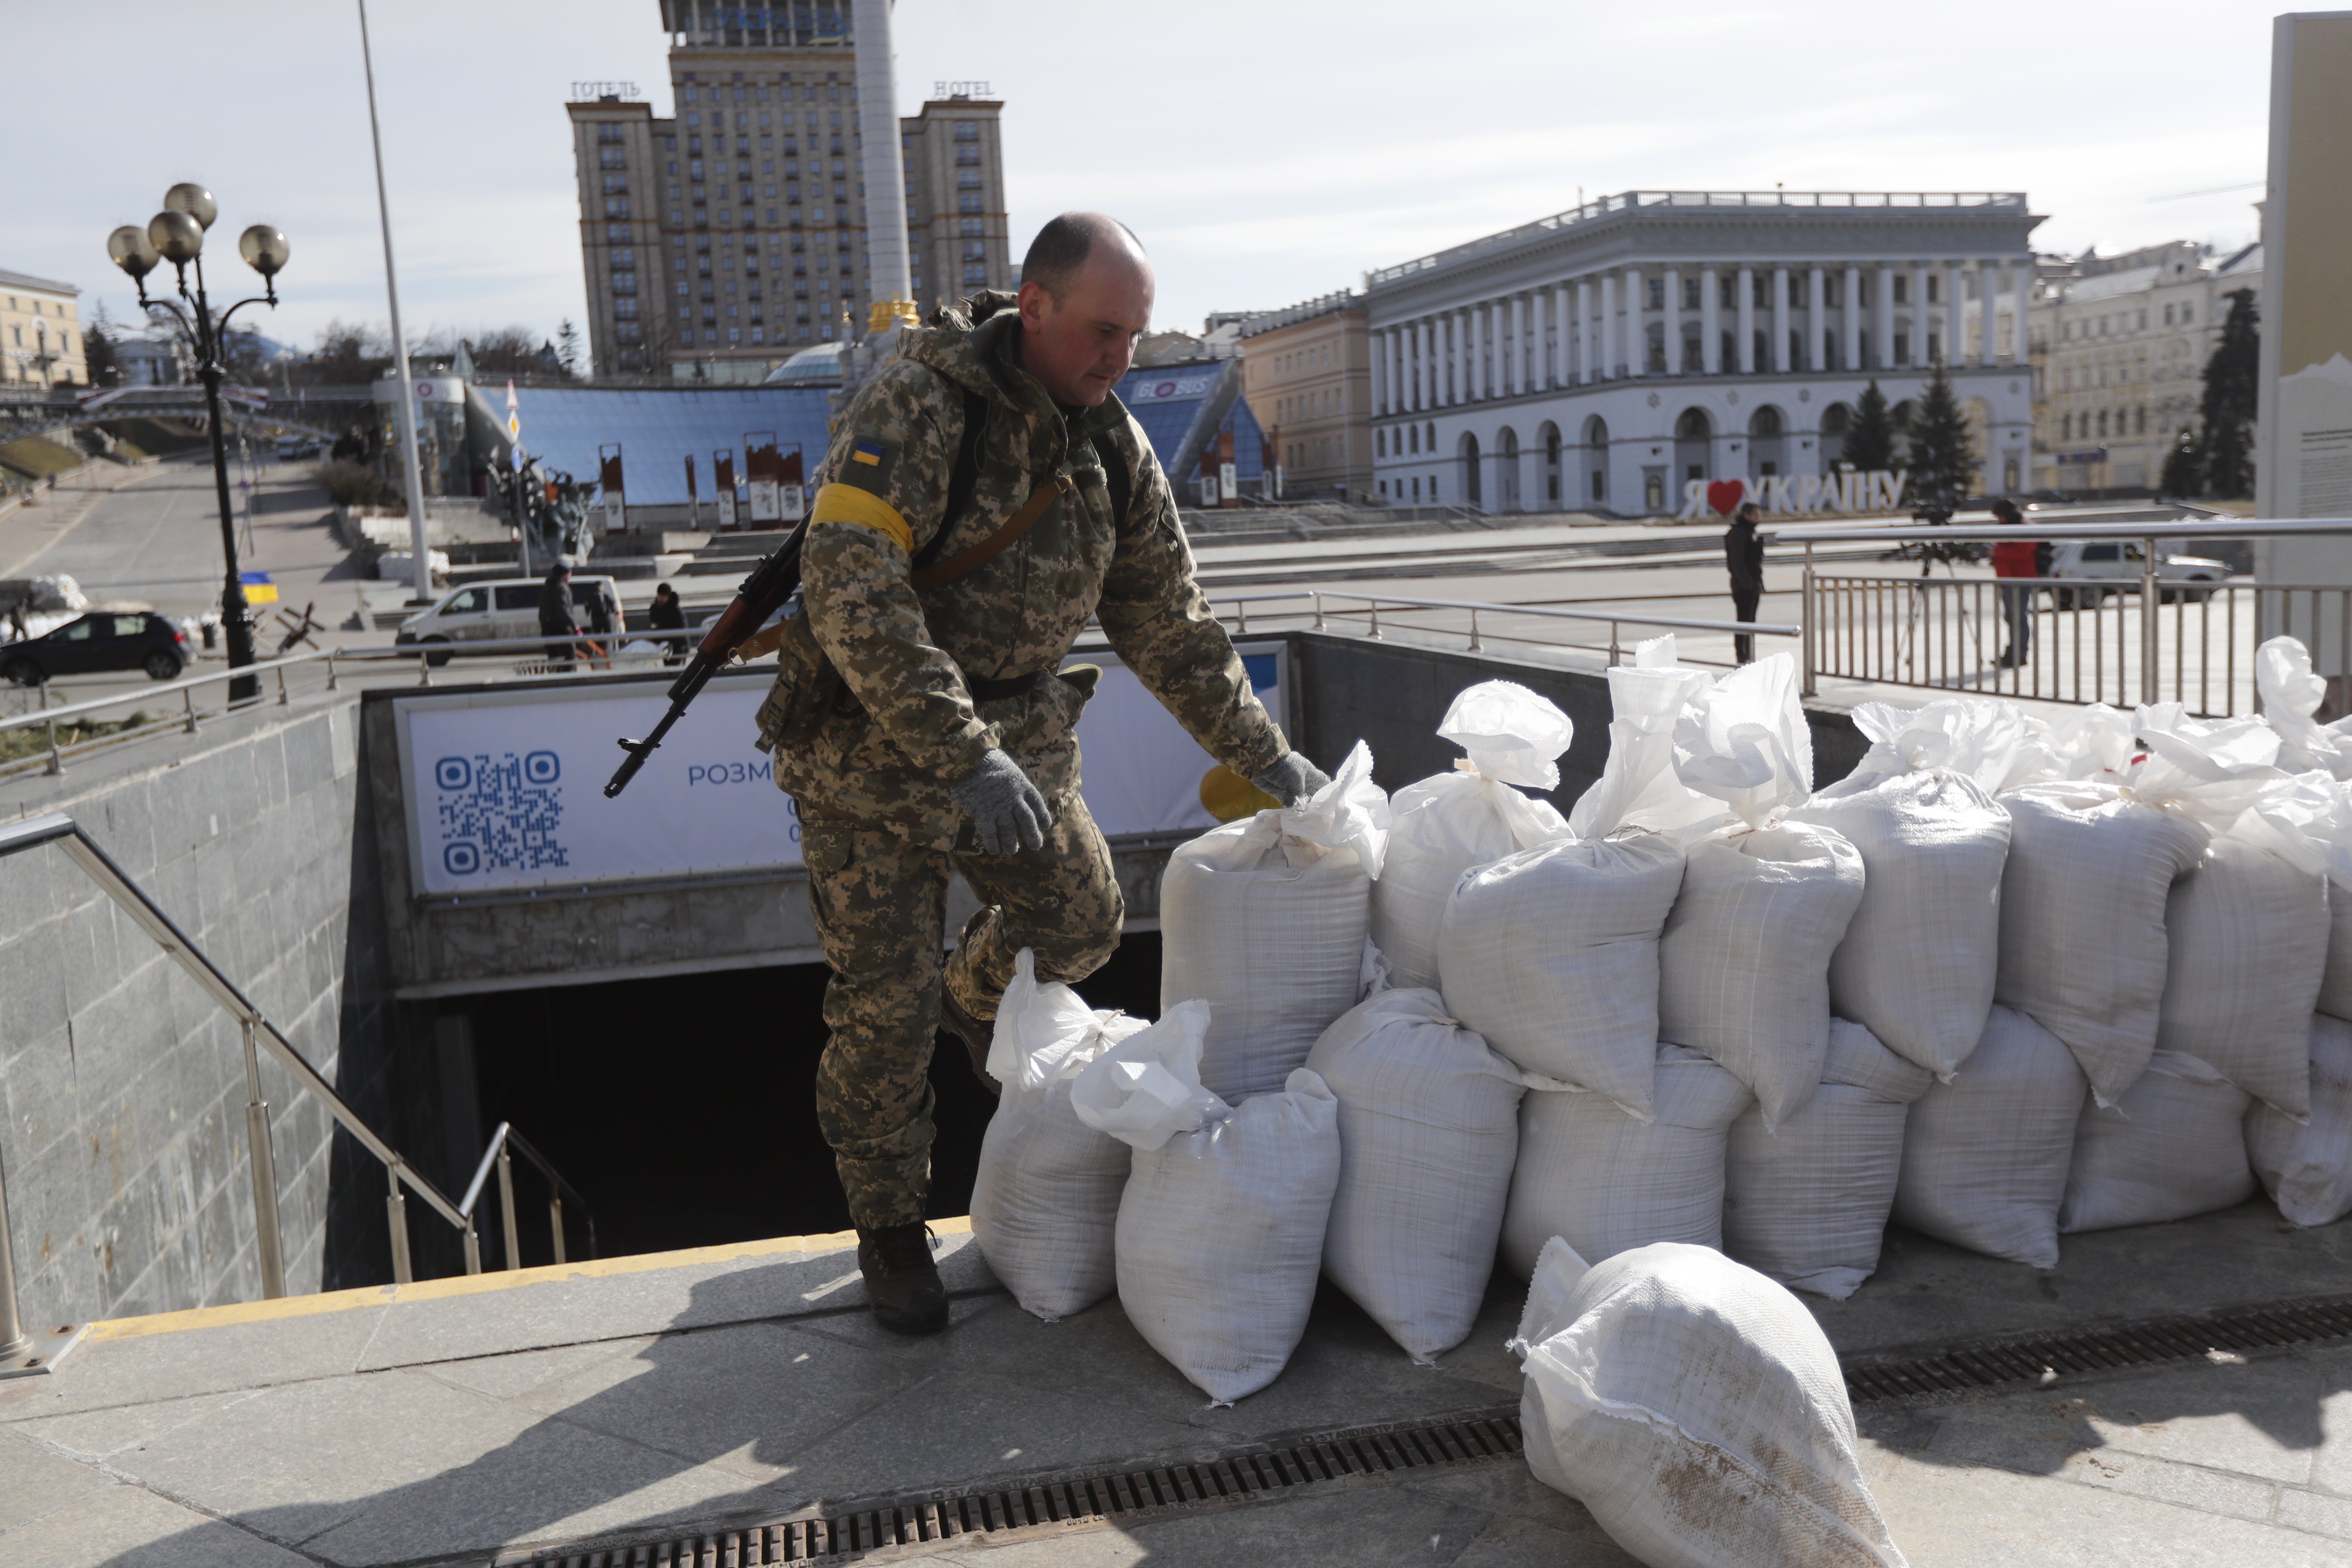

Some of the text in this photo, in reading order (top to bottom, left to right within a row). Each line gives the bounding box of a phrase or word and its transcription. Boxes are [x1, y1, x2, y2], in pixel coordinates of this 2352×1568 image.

[934, 82, 995, 96] HOTEL
[1138, 377, 1209, 398] GLOBUS
[1678, 461, 1908, 519] Я УКРАЇНУ
